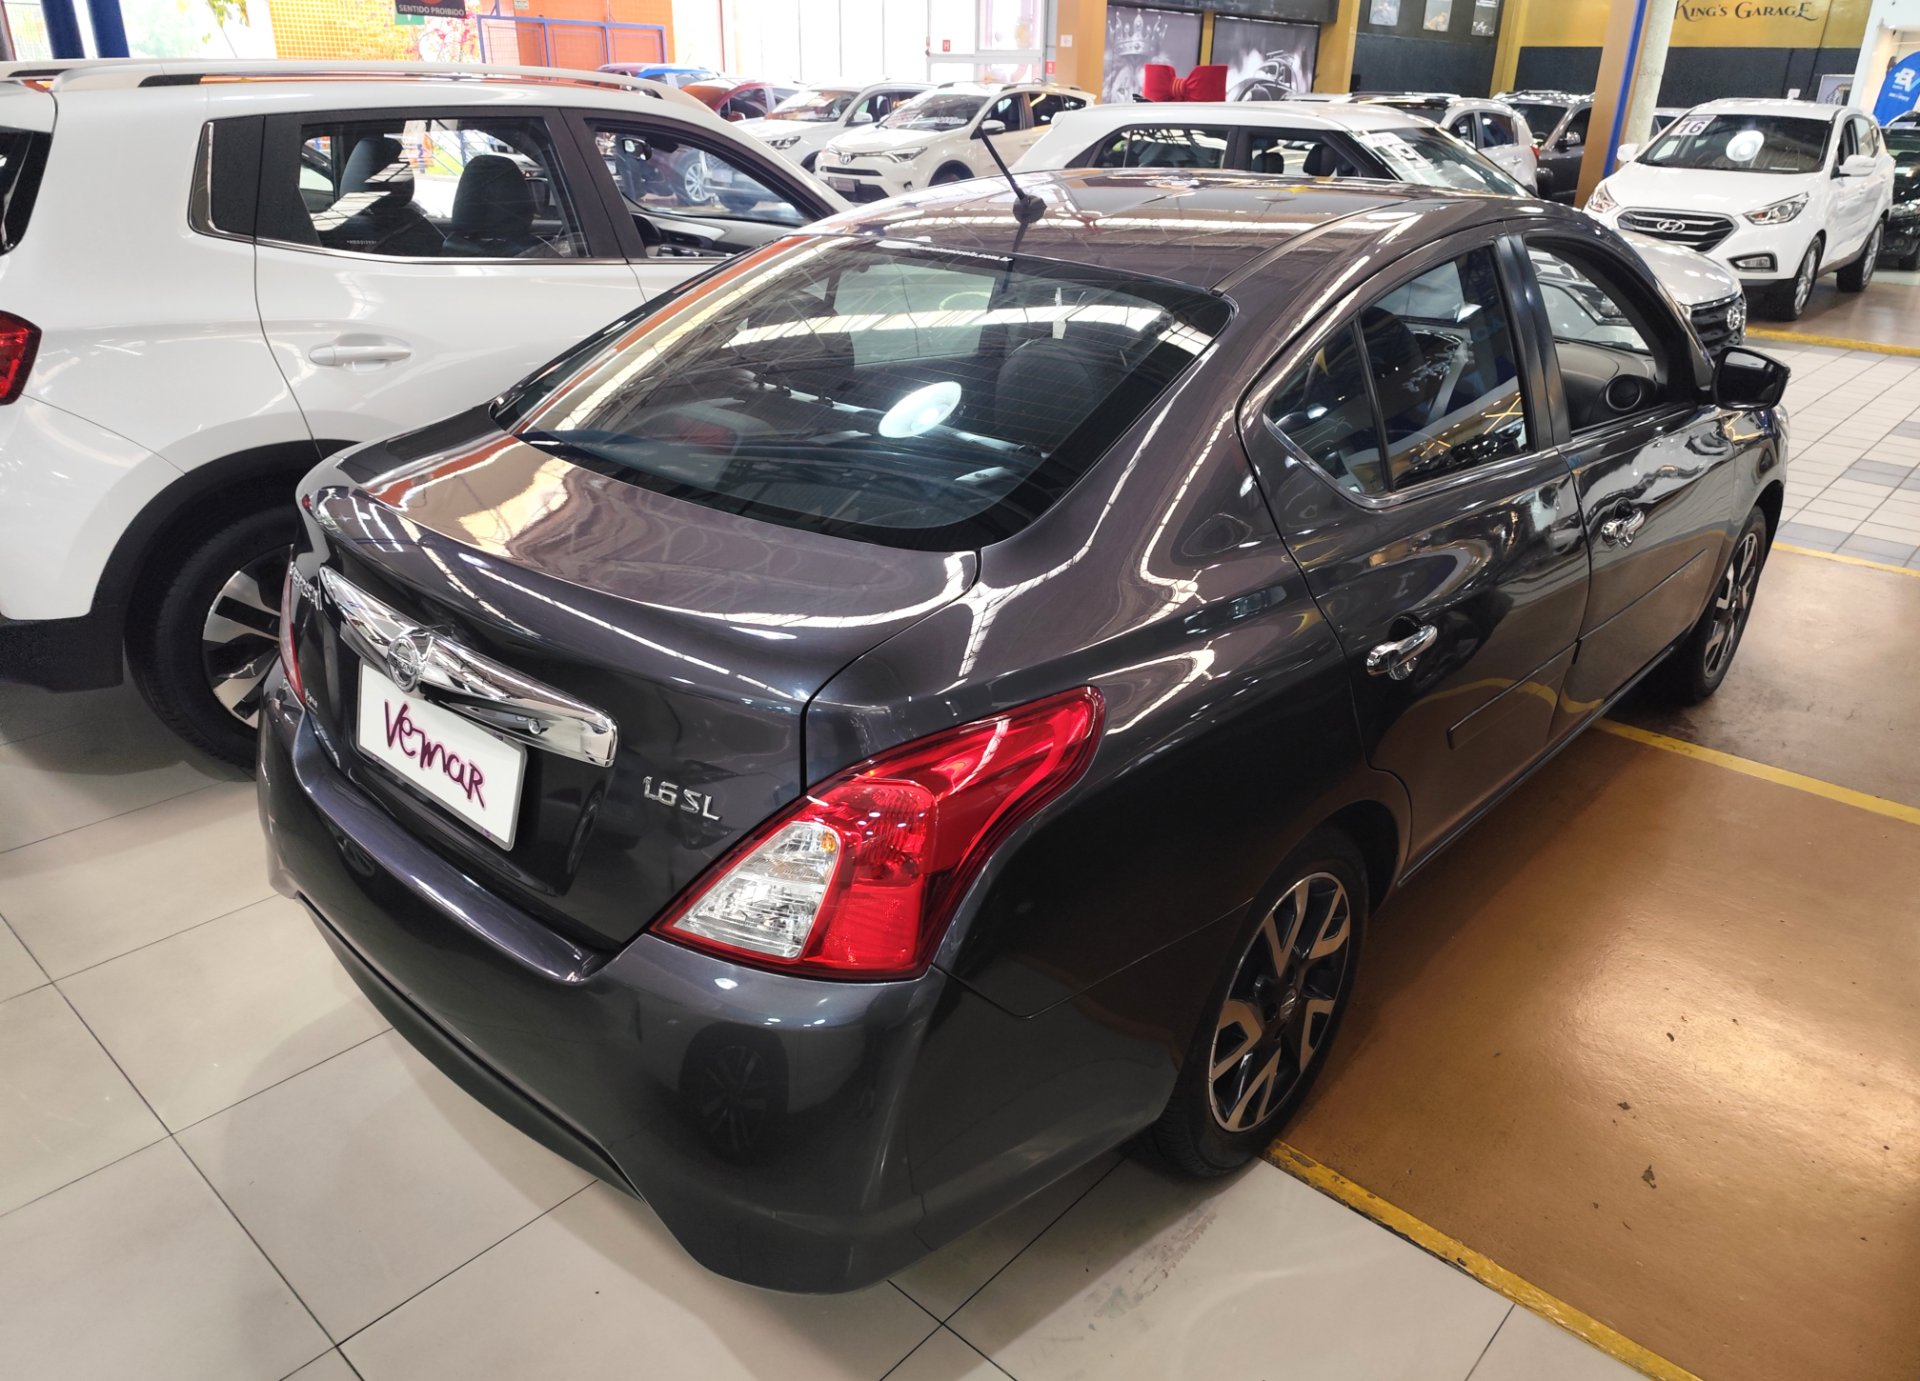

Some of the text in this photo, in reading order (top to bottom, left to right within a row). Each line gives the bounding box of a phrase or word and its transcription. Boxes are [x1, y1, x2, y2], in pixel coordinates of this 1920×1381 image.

[398, 4, 465, 17] SENTIDO PROIBIDO
[1735, 1, 1819, 21] GARAGE
[1679, 121, 1706, 134] 16
[643, 775, 721, 821] 1.6 SL
